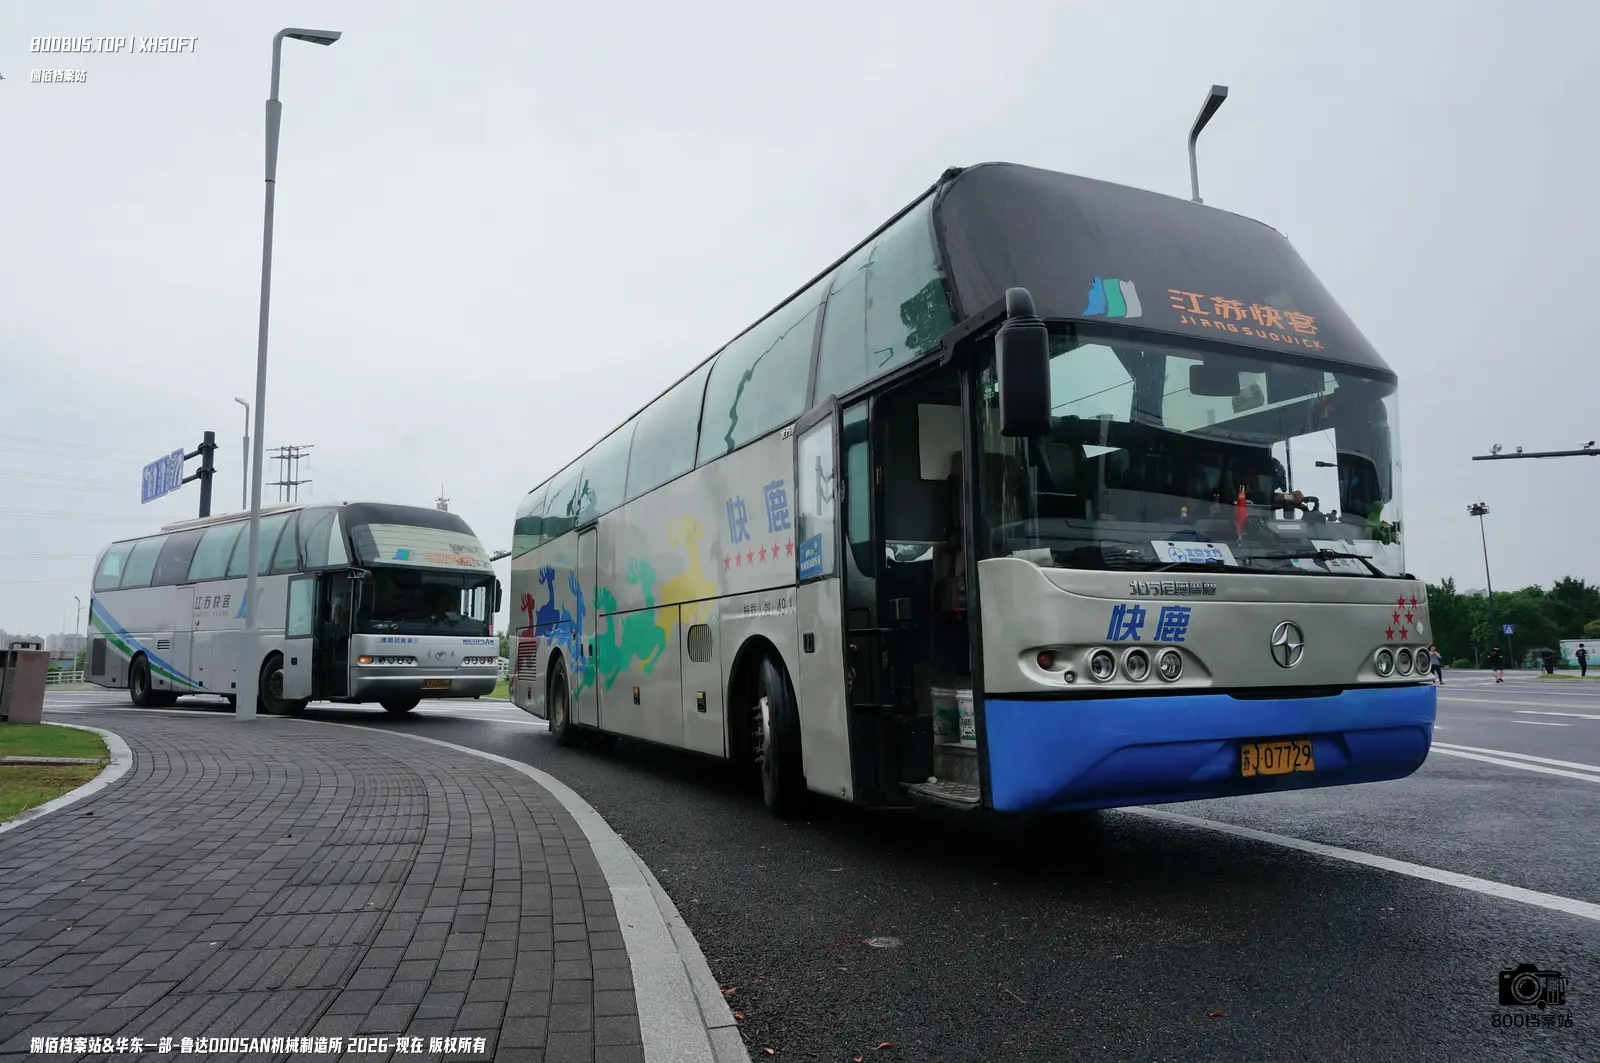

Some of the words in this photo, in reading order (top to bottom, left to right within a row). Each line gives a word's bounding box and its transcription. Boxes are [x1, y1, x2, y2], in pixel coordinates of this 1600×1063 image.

[1168, 288, 1318, 335] 江苏快客
[194, 594, 231, 610] 江苏快客
[1106, 603, 1192, 642] 快鹿
